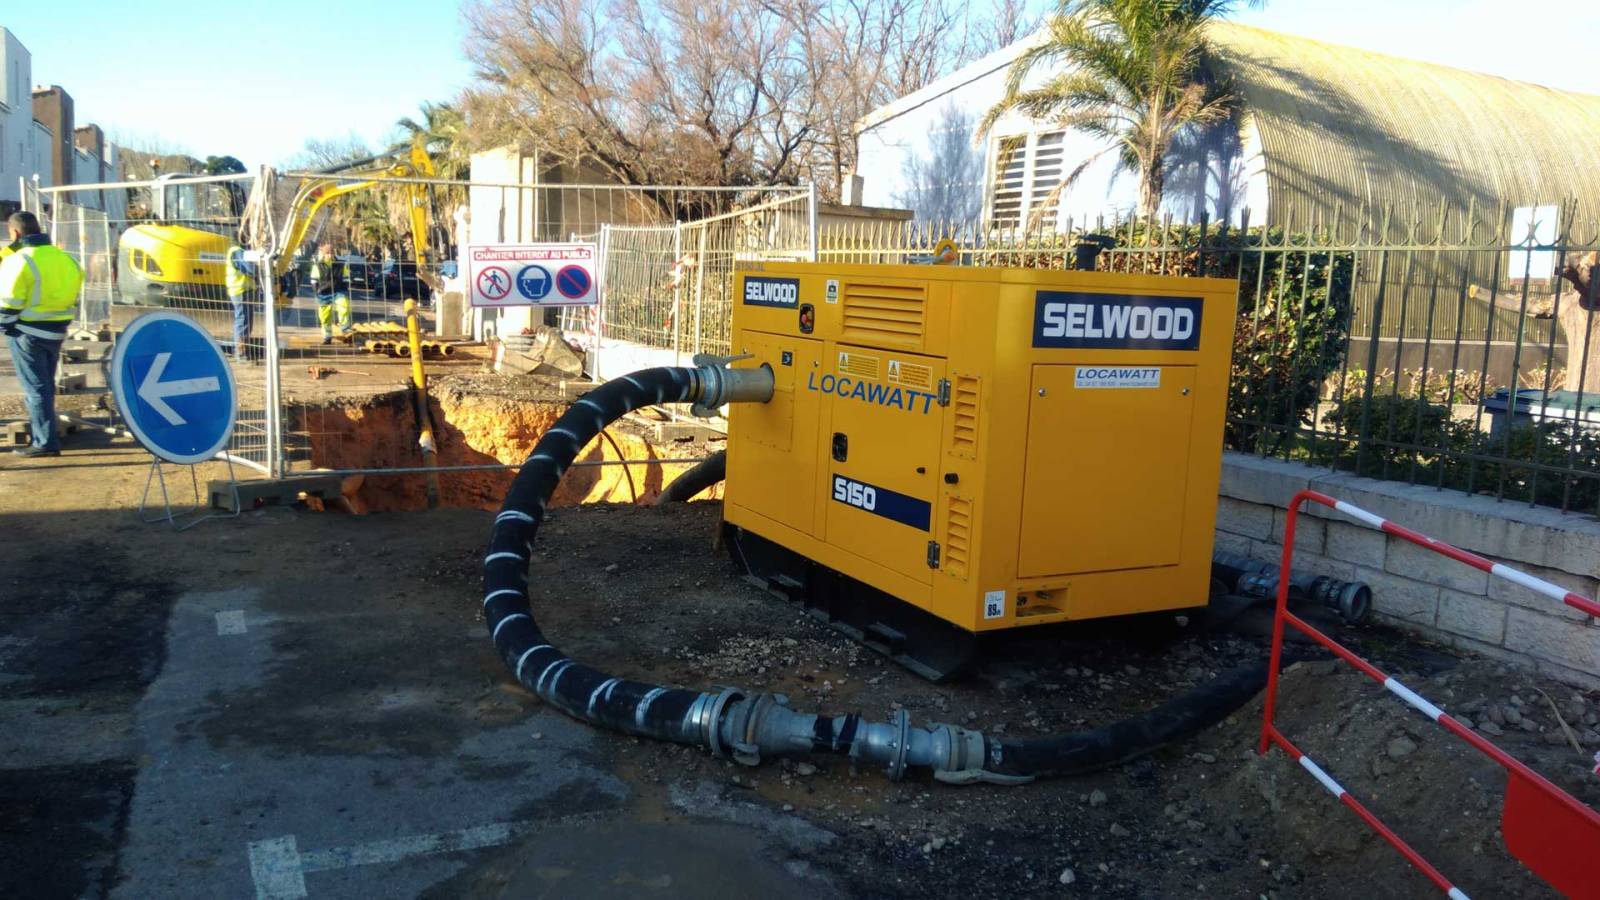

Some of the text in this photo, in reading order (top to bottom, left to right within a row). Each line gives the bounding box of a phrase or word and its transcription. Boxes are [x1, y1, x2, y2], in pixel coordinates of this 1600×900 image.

[550, 250, 560, 259] AU
[745, 282, 797, 303] SELWOOD
[1043, 303, 1194, 340] SELWOOD
[1077, 369, 1160, 379] LOCAWATT
[808, 372, 938, 415] LOCAWATT
[834, 477, 877, 512] S150
